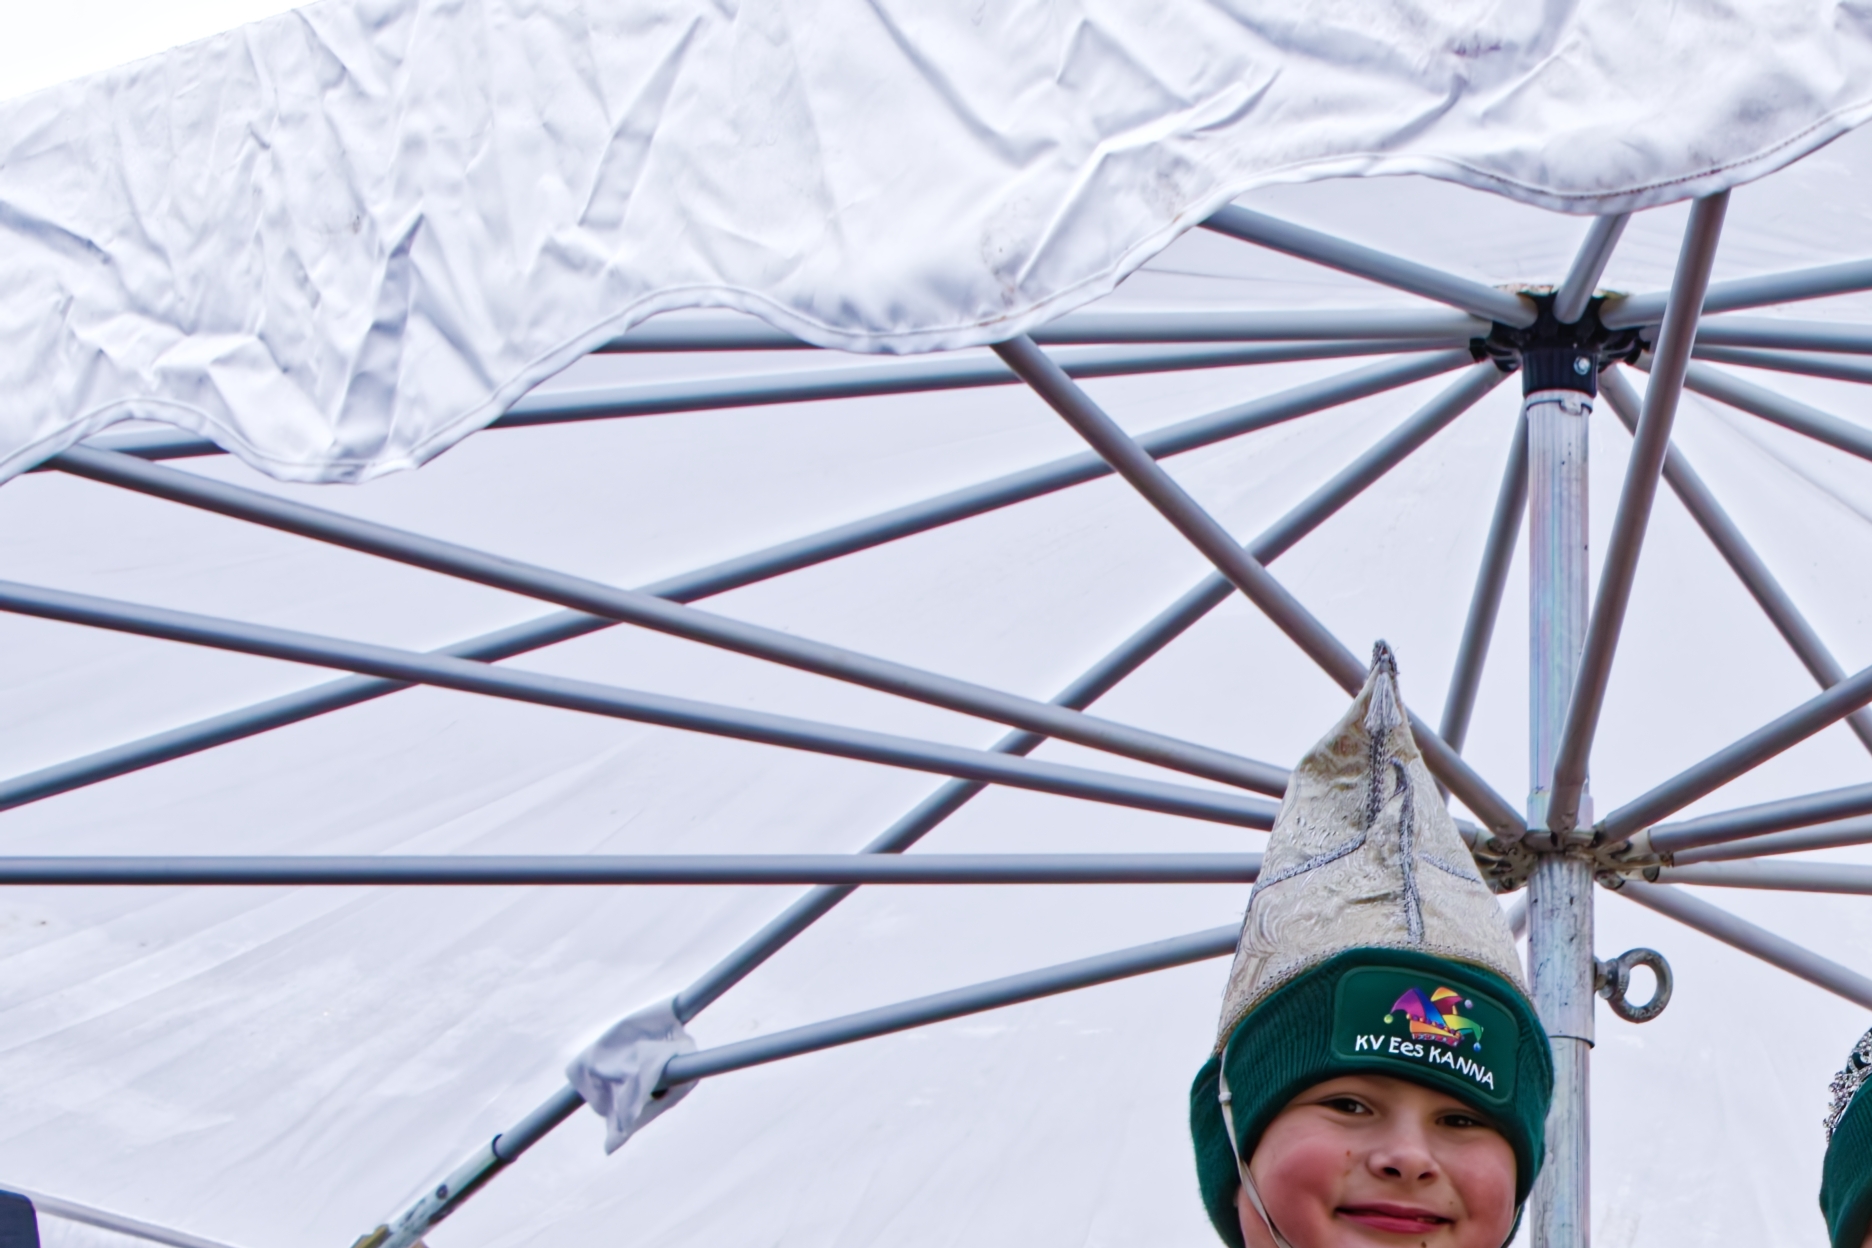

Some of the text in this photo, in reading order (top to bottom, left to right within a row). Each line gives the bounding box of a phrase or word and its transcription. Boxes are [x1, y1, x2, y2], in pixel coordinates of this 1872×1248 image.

[1355, 1034, 1495, 1091] KV Ees KANNA
